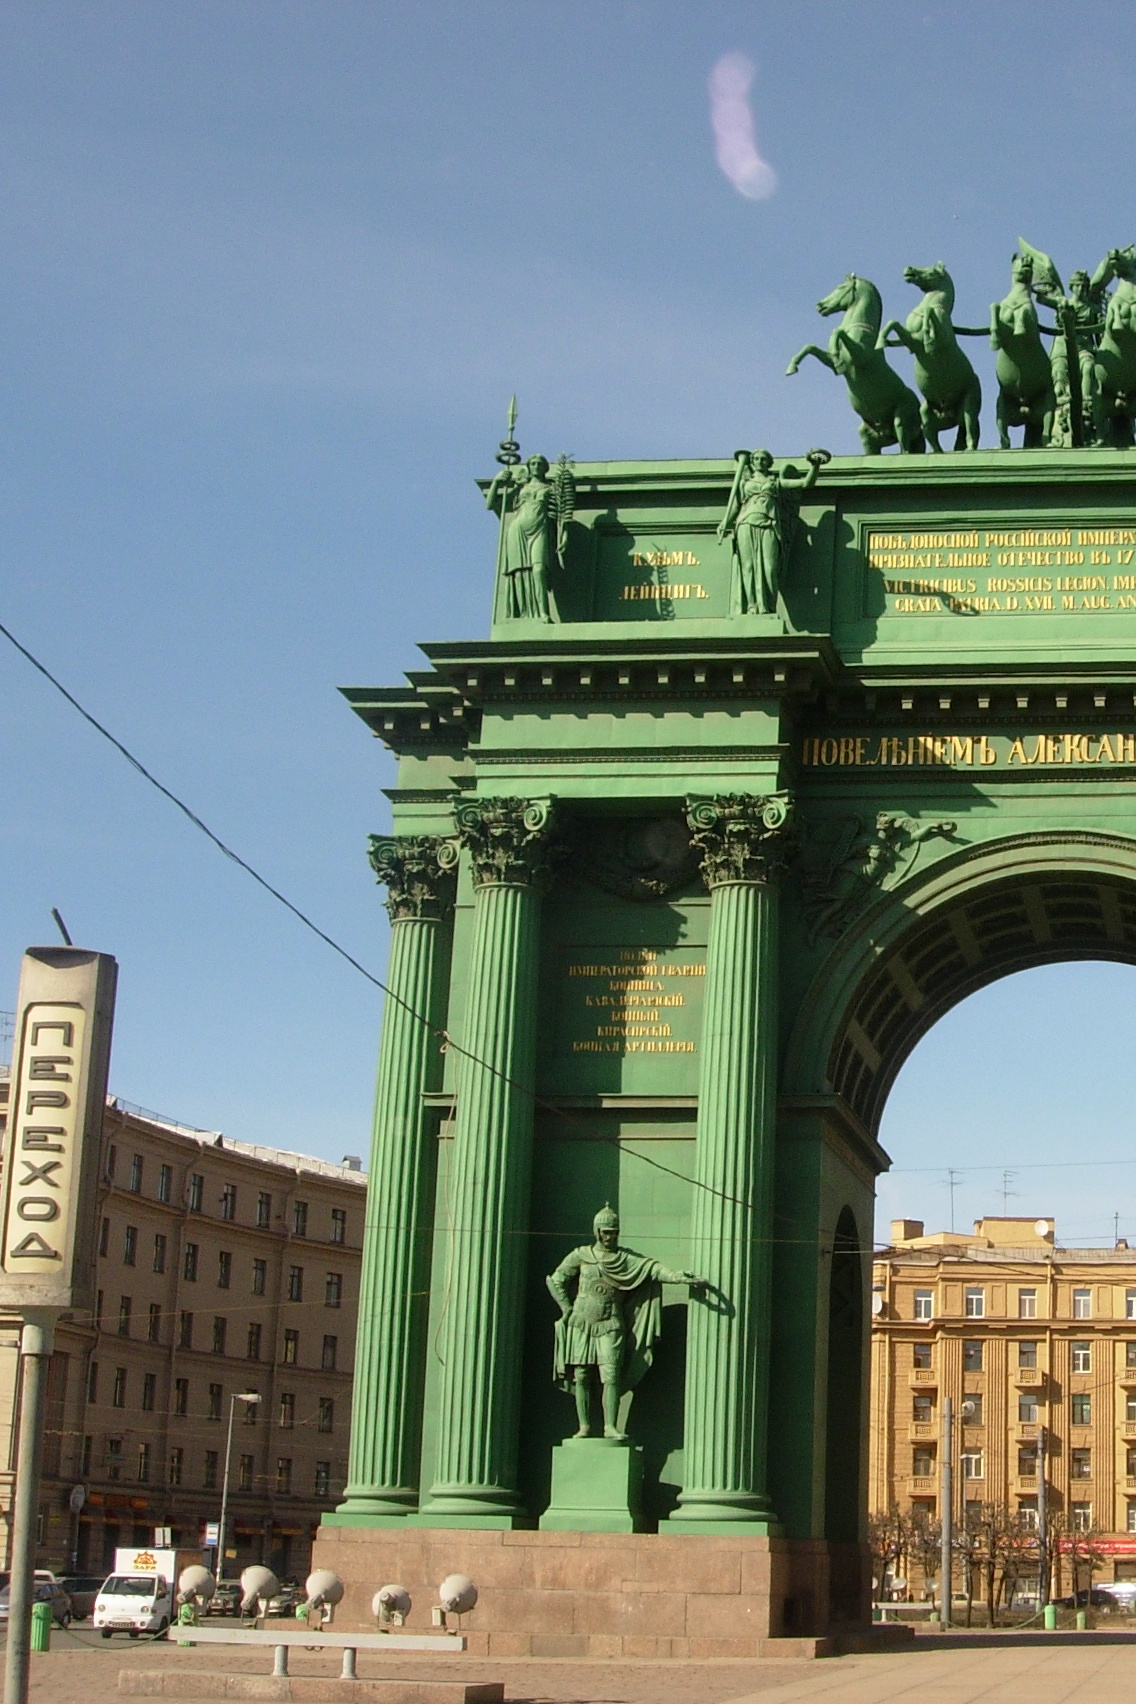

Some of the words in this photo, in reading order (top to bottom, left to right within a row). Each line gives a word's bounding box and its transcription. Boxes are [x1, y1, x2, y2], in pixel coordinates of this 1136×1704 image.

[869, 552, 991, 568] ПРИЗНАТЕЛЬНОЕ
[998, 550, 1084, 567] ОТЕЧЕСТВО
[1090, 550, 1112, 565] ВЪ
[1117, 549, 1135, 564] 17
[884, 577, 976, 594] VICTRICIBUS
[987, 577, 1052, 593] ROSSICIS
[1057, 576, 1110, 592] LEGION.
[10, 1020, 73, 1258] ПЕРЕХОД
